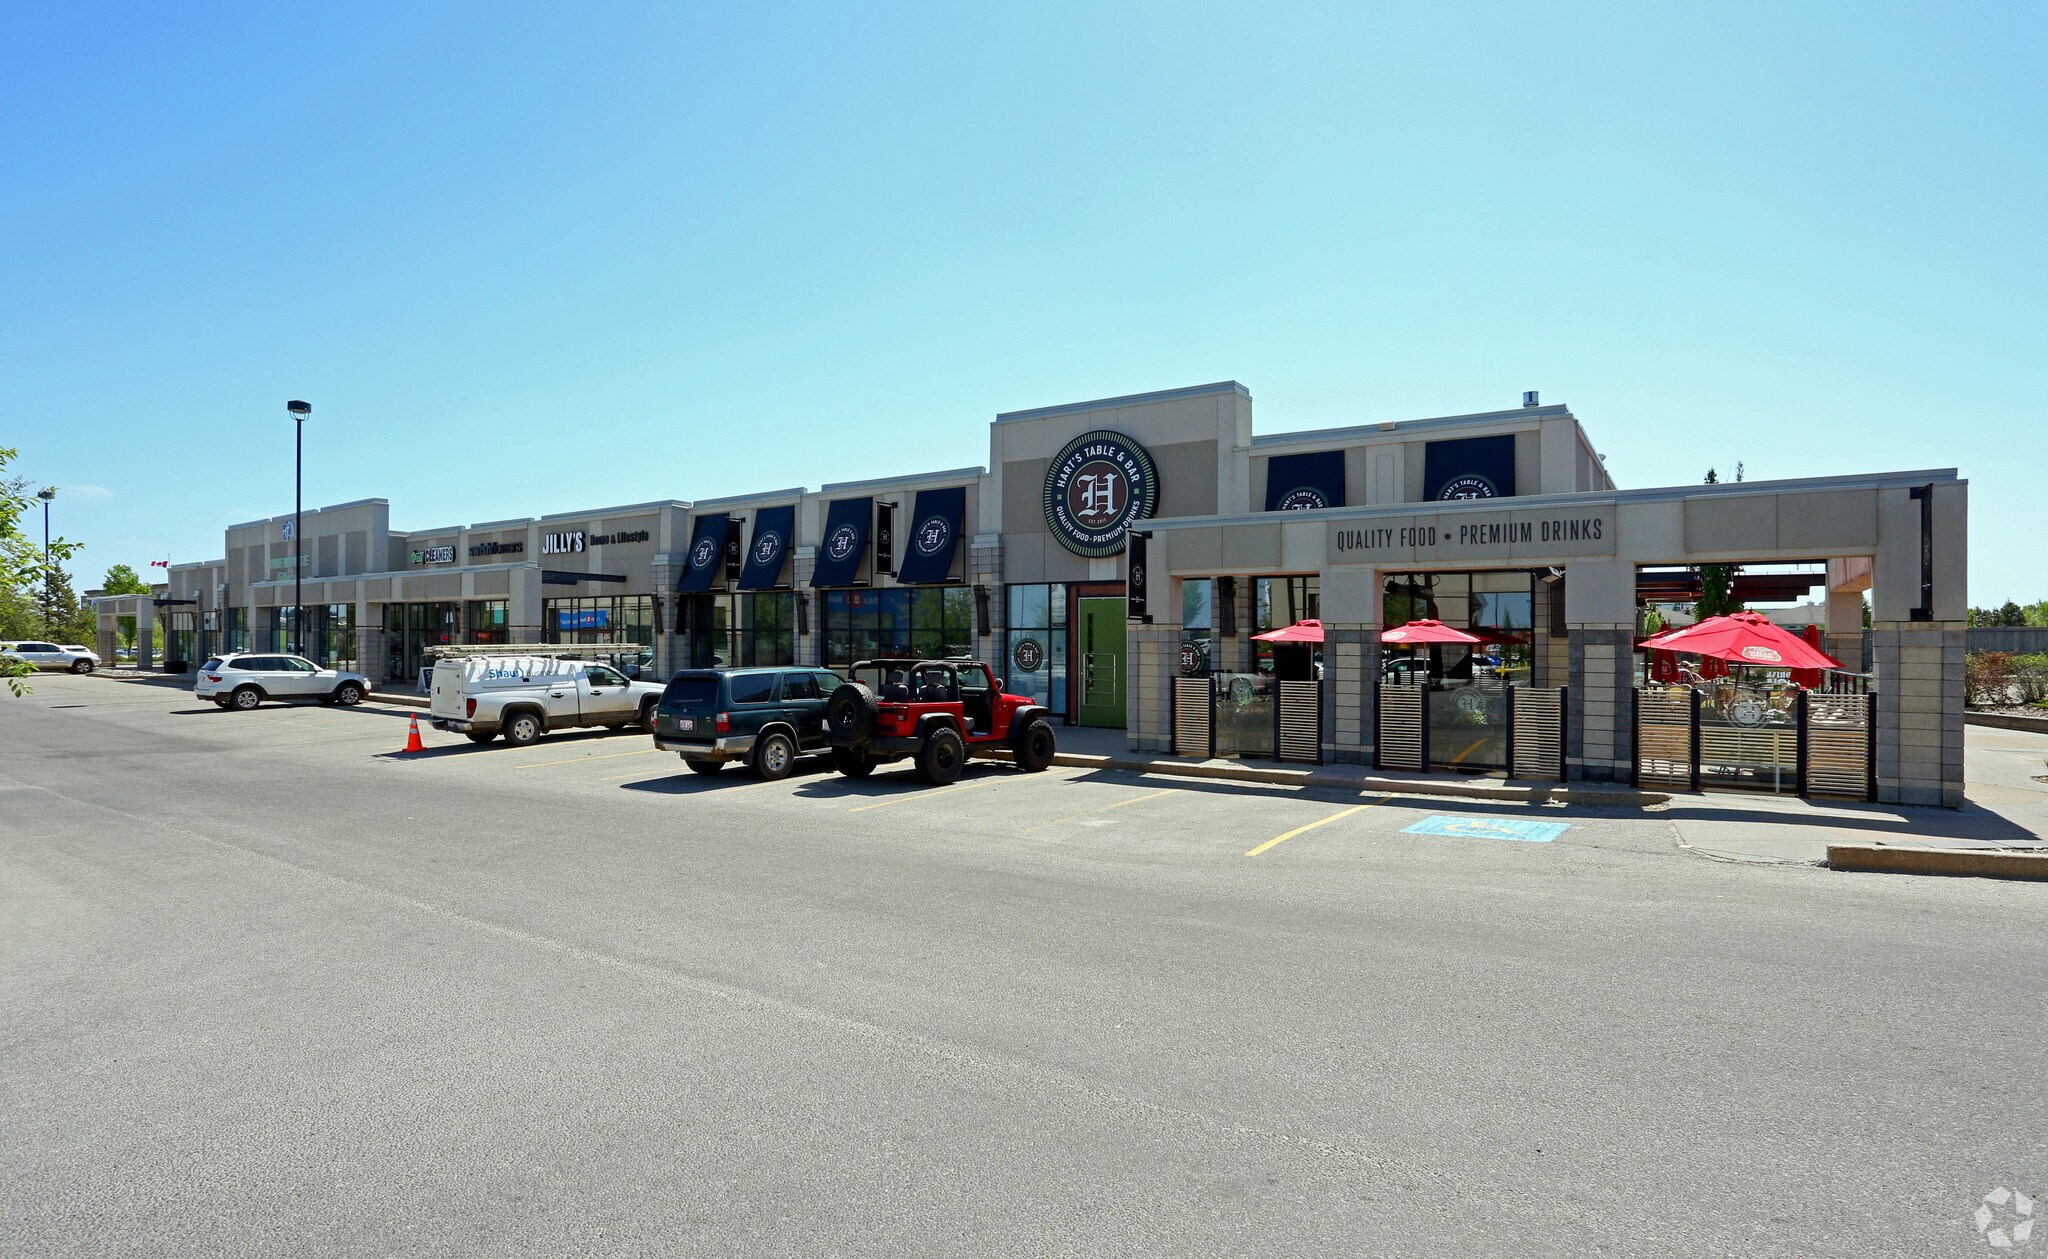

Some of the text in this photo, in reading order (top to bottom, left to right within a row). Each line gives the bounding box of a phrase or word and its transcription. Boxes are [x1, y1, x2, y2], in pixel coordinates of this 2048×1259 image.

[1056, 445, 1140, 488] HART'S TABLE & BAR
[1076, 472, 1118, 517] H
[1482, 486, 1492, 497] BAR
[1056, 500, 1141, 543] QUALITY FOOD PREMIUM DRINKS
[542, 531, 583, 554] JILLY'S
[590, 534, 609, 546] Home
[617, 530, 649, 544] Lifestyle
[1337, 518, 1602, 552] QUALITY FOOD PREMIUM DRINKS
[425, 546, 454, 564] CLEANERS
[488, 668, 520, 678] Shaw
